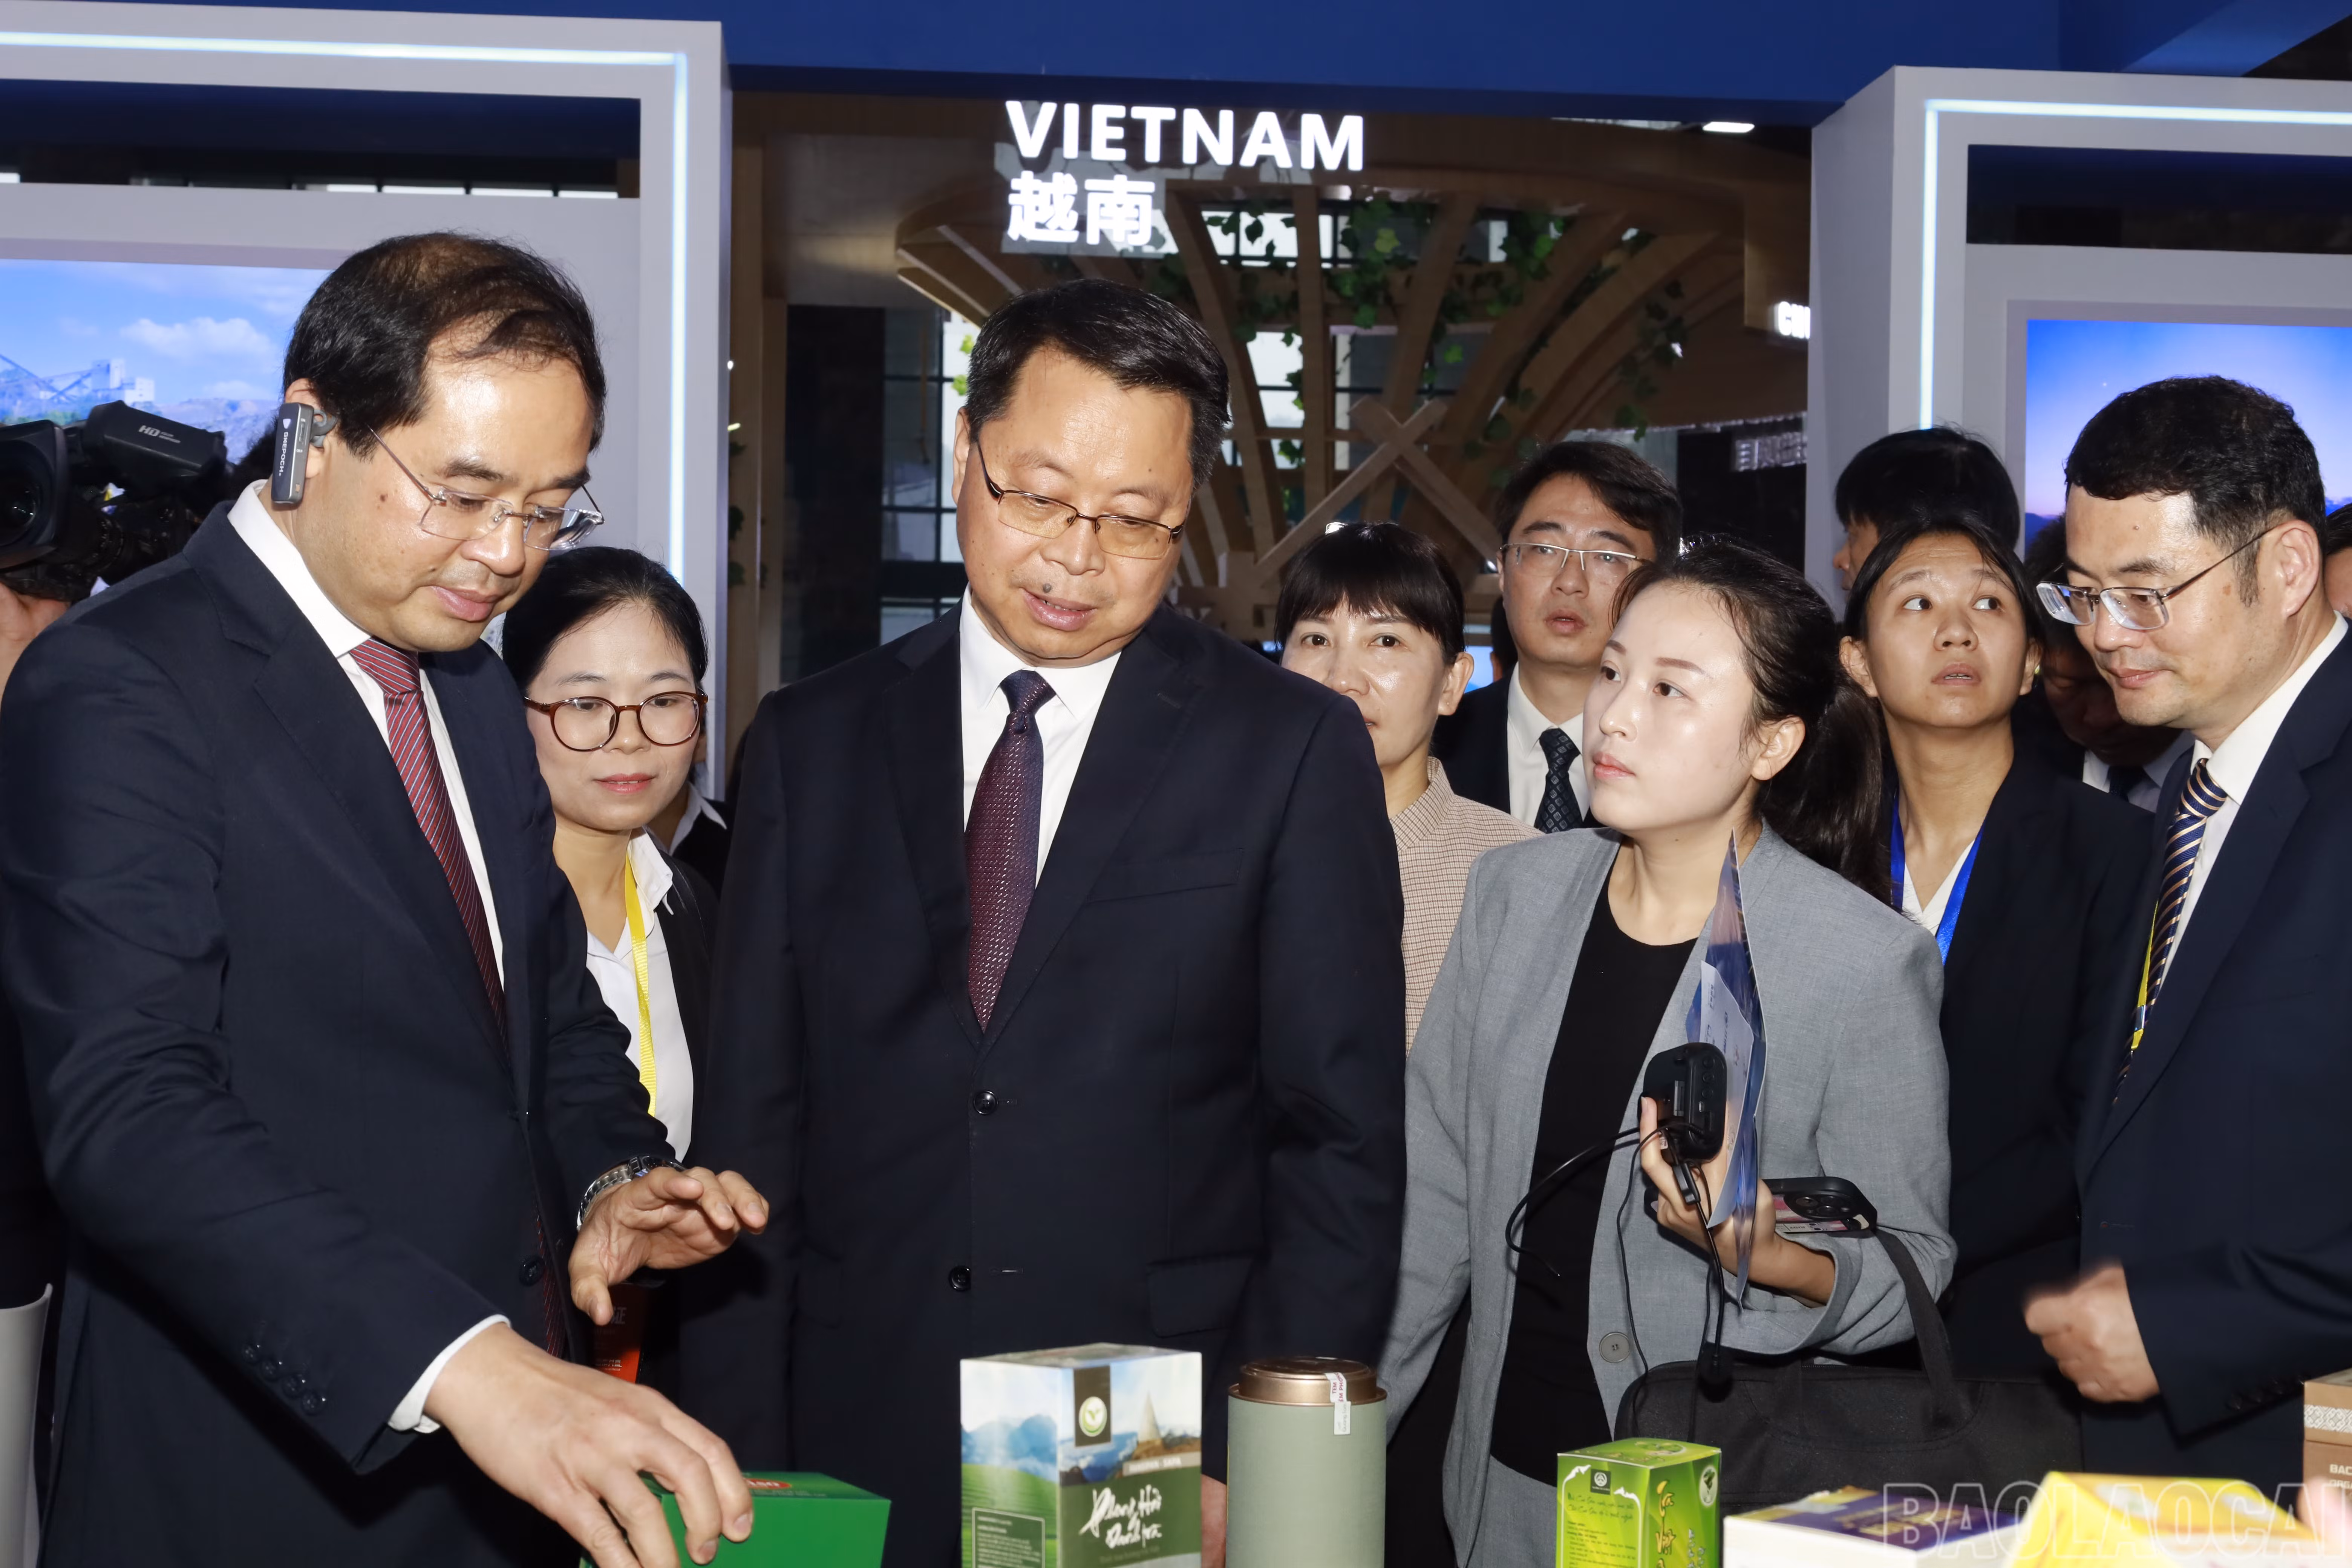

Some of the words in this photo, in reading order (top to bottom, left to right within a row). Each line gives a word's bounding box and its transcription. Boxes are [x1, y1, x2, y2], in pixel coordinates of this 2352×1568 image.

[1005, 100, 1364, 172] VIETNAM
[1007, 170, 1156, 246] 越南
[138, 425, 160, 437] HD
[279, 432, 288, 473] SKEPOCH
[2330, 1479, 2352, 1488] ORG
